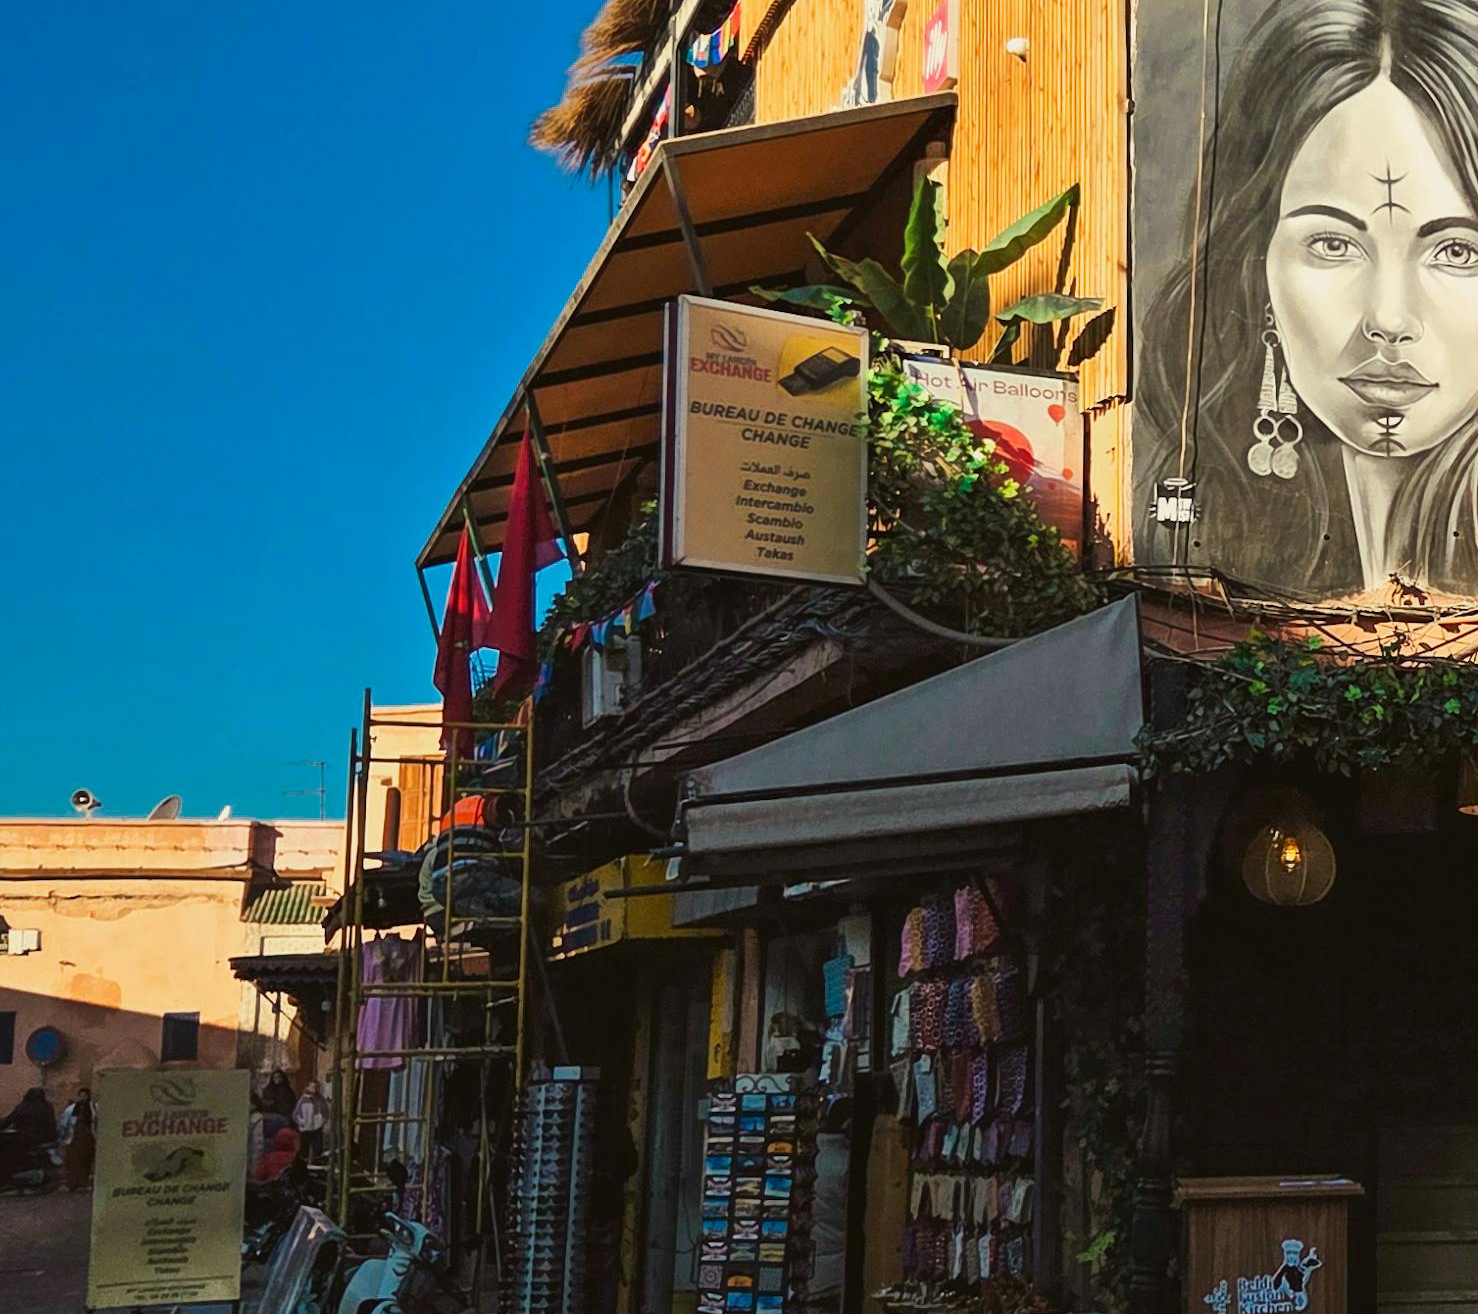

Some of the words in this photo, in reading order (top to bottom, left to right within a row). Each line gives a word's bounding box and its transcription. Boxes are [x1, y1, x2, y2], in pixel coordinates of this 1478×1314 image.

[689, 357, 772, 383] EXCHANGE
[915, 372, 952, 389] Hot
[993, 379, 1078, 404] Balloons
[690, 400, 760, 423] BUREAU
[764, 411, 788, 426] DE
[791, 415, 860, 437] CHANGE
[741, 427, 811, 449] CHANGE
[743, 479, 807, 498] Exchange
[736, 495, 815, 515] Intercambio
[747, 512, 804, 530] Scambio
[745, 529, 805, 547] Austaush
[756, 546, 795, 562] Takas
[122, 1117, 230, 1138] EXCHANGE
[1239, 1276, 1272, 1291] Beldi
[1240, 1301, 1292, 1314] Kitchen
